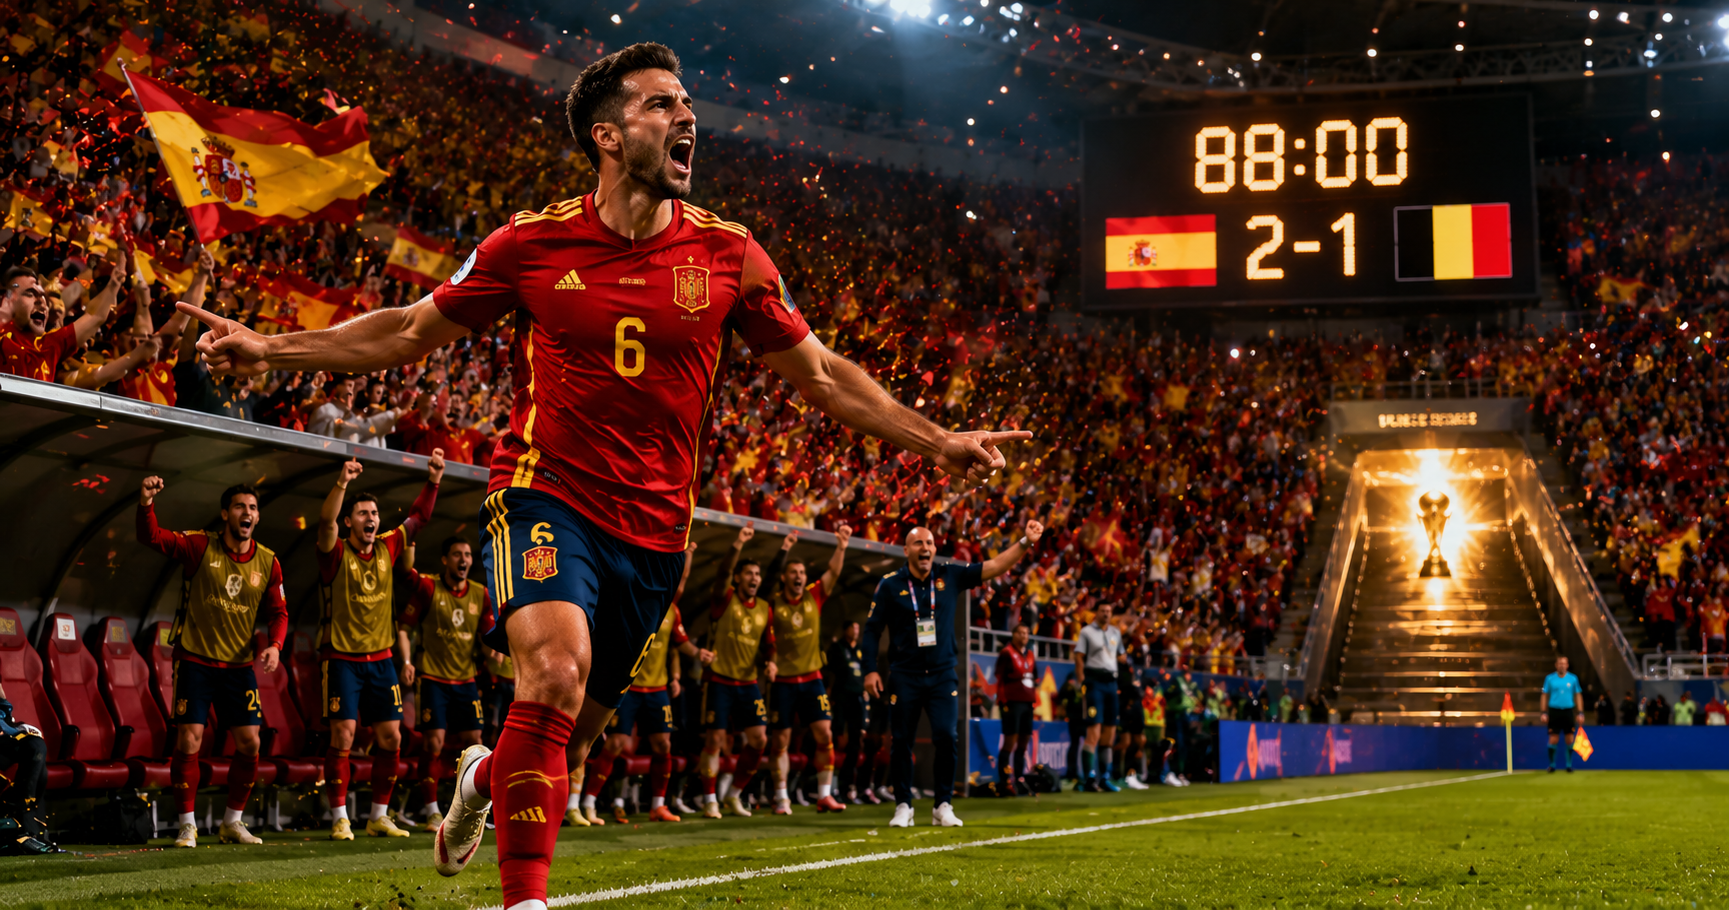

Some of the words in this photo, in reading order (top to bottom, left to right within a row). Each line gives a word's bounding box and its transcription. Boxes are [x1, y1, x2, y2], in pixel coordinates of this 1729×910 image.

[1194, 116, 1408, 193] 88:00
[614, 316, 646, 377] 6
[530, 521, 555, 544] 6
